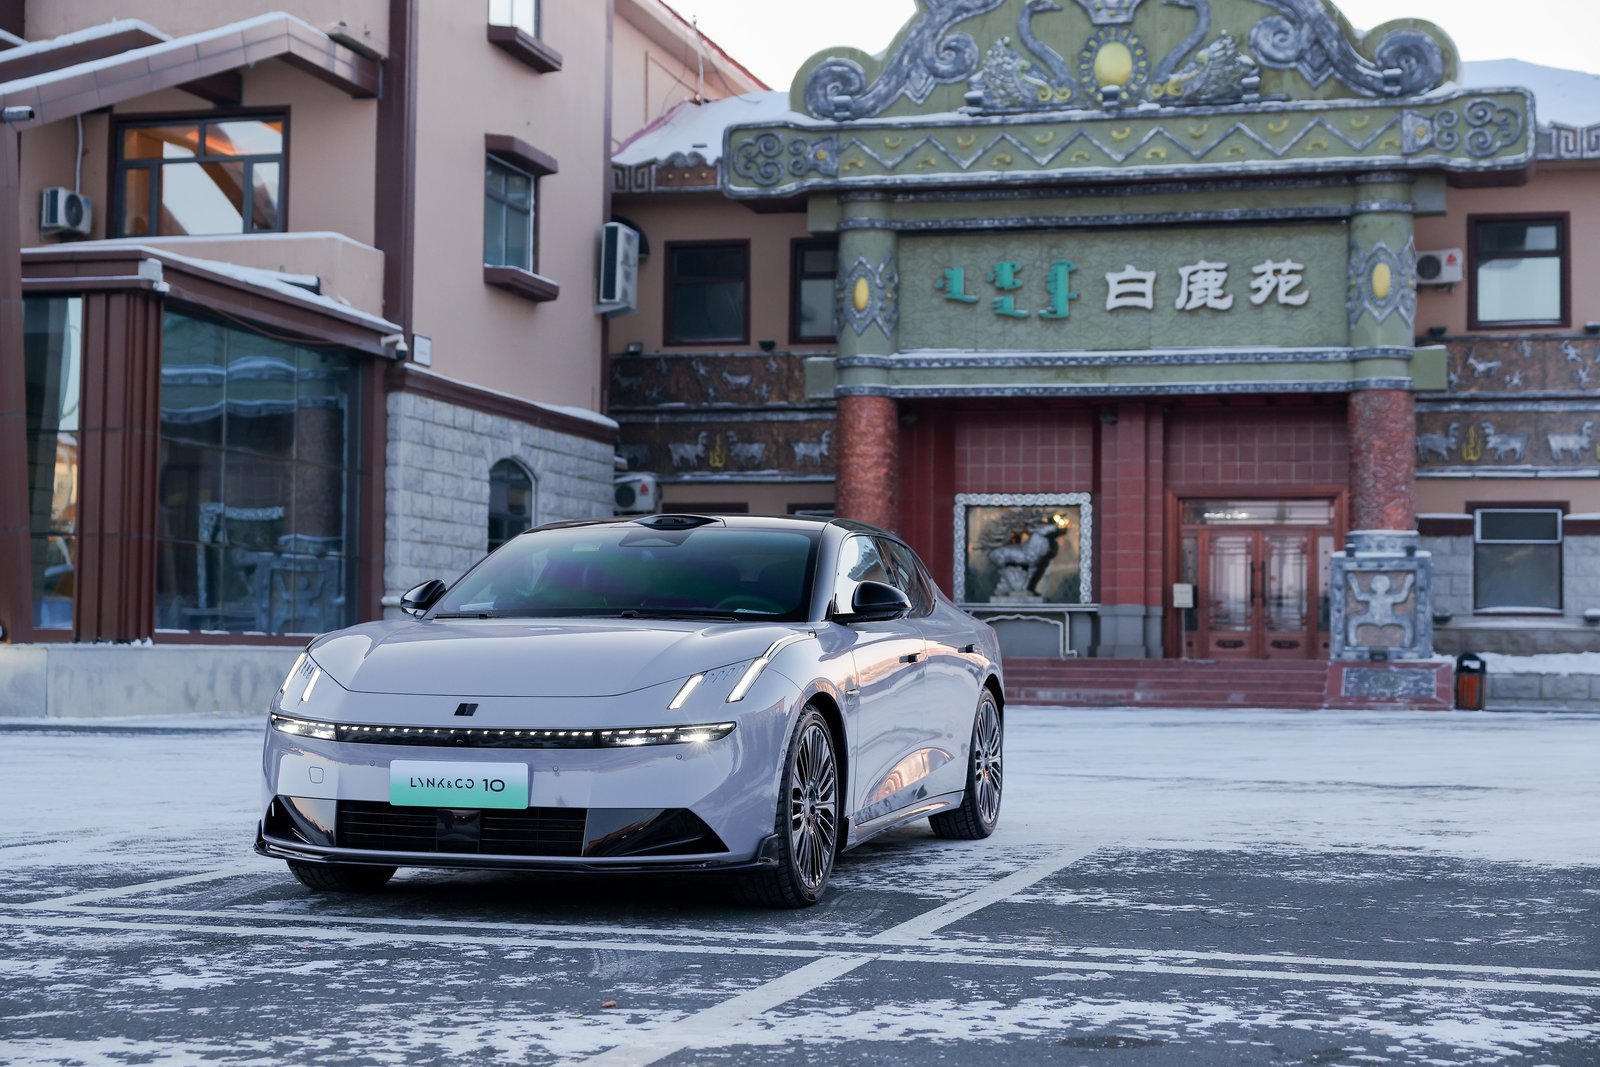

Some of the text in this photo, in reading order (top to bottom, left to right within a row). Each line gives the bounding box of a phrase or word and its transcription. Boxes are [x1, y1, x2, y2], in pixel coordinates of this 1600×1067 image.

[1105, 259, 1310, 311] 白鹿苑
[410, 777, 505, 792] LYNK&CO 10
